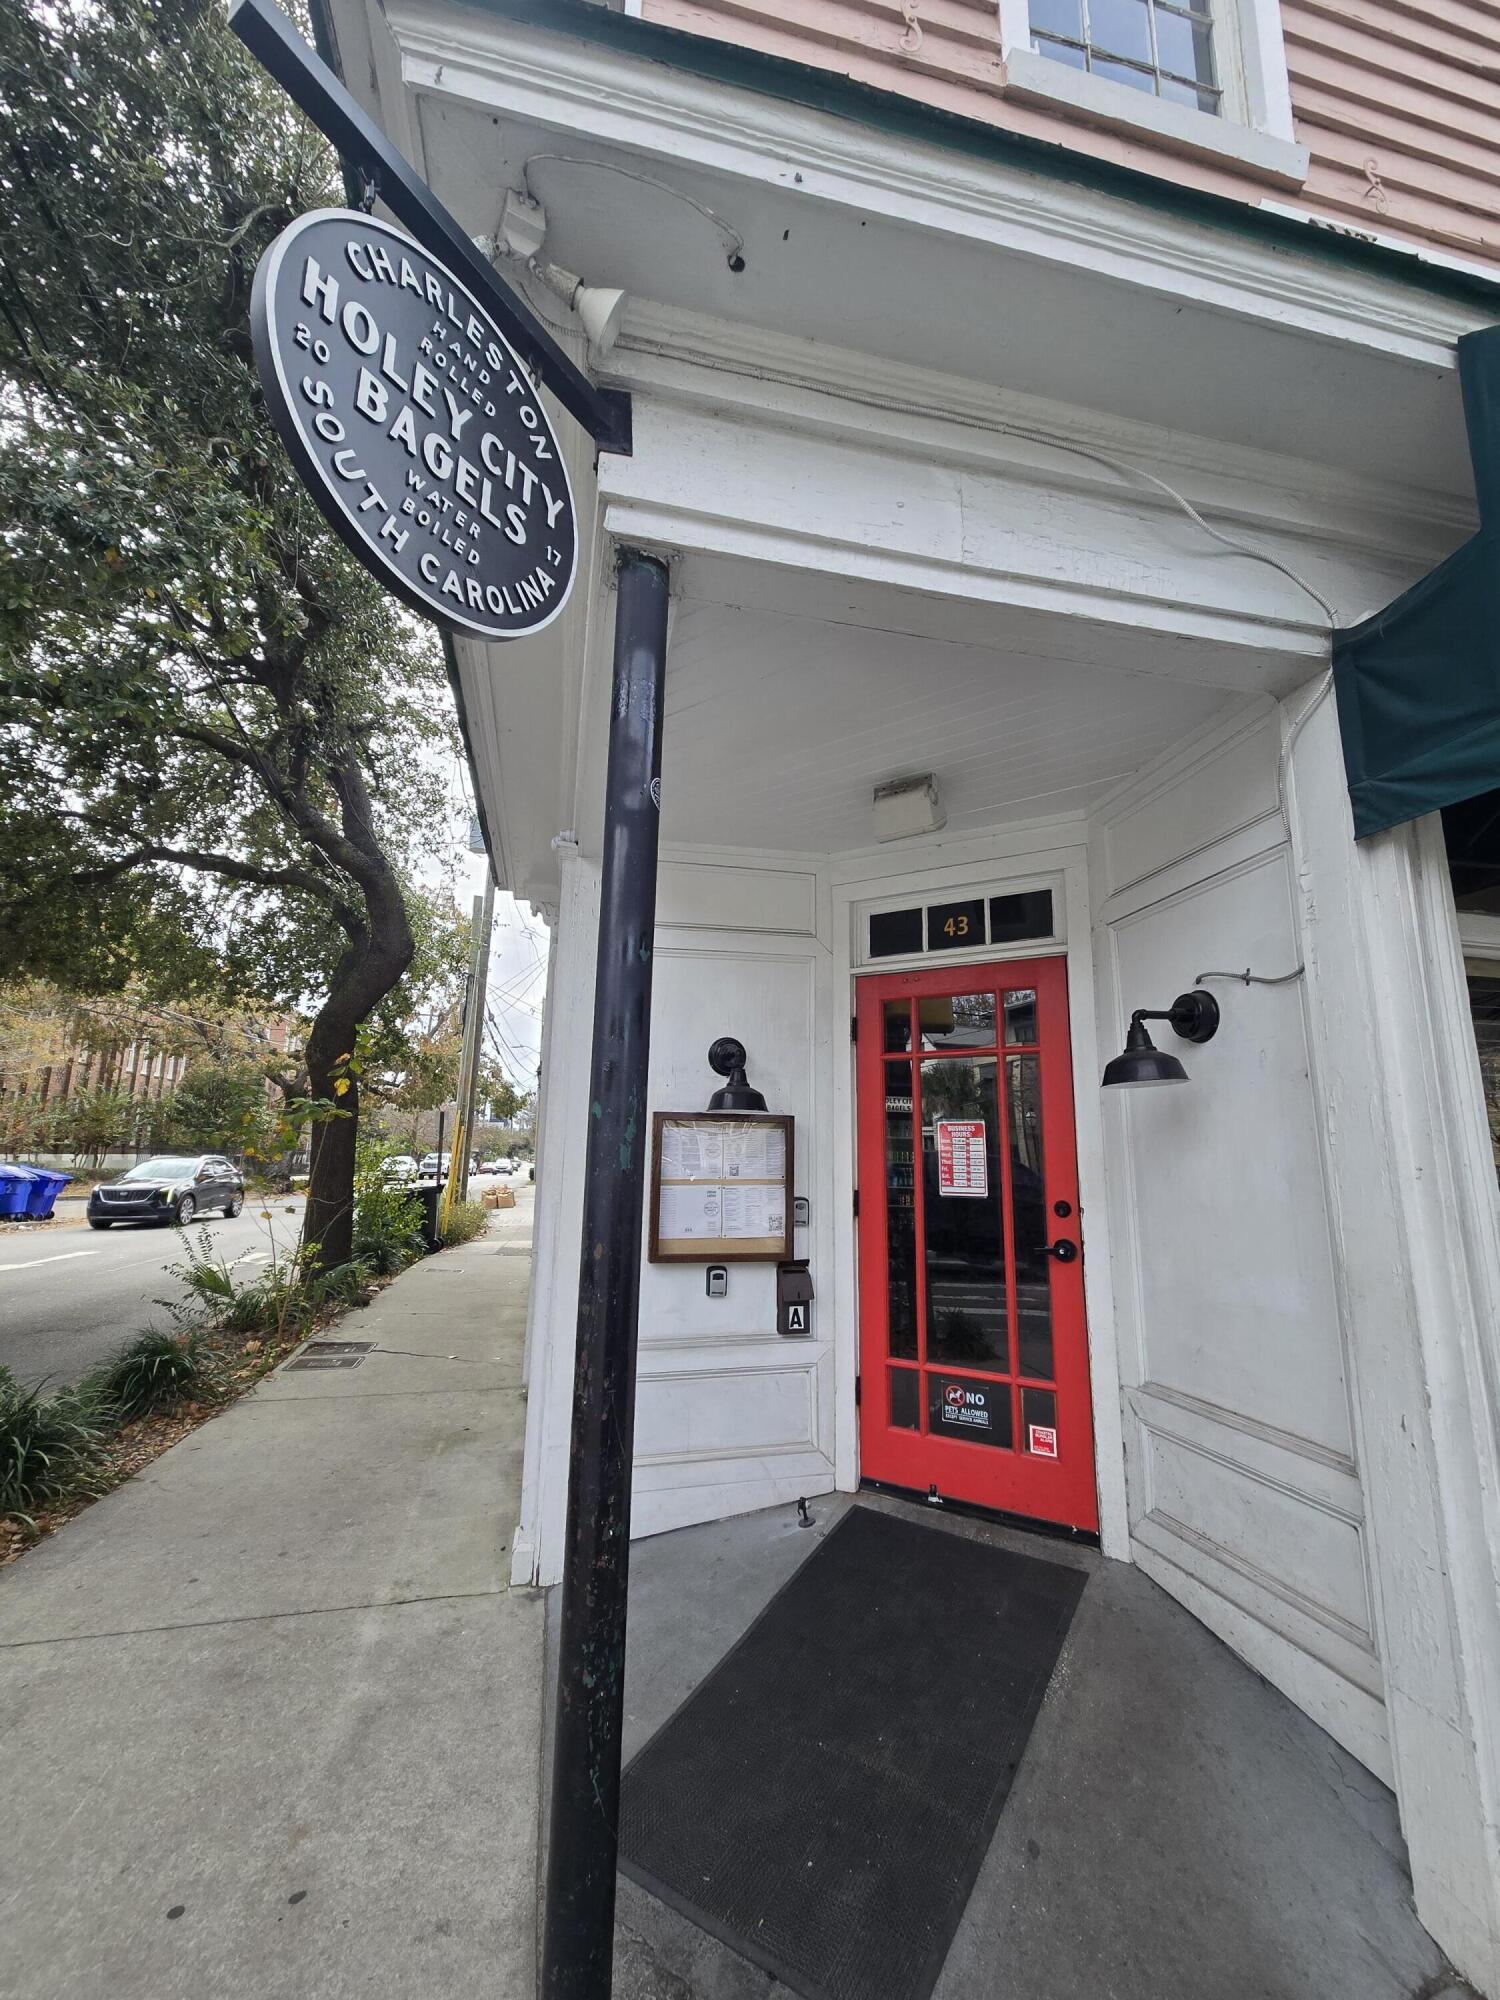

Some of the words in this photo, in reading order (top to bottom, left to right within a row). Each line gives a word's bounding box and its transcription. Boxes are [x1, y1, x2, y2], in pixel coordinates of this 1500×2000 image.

[295, 322, 331, 364] 20
[346, 240, 553, 460] CHARLESTON
[432, 320, 491, 386] HAND
[303, 256, 474, 441] HOLEY
[480, 431, 565, 530] CITY
[419, 336, 497, 418] ROLLED
[356, 366, 527, 545] BAGELS
[303, 375, 409, 553] SOUTH
[419, 552, 556, 615] CAROLINA
[406, 468, 481, 540] WATER
[400, 497, 481, 566] BOILED
[545, 545, 562, 566] 17
[943, 916, 969, 936] 43
[886, 1104, 911, 1112] BAGELS
[789, 1307, 803, 1328] A
[945, 1405, 959, 1414] PETS
[961, 1407, 989, 1418] ALLOWED
[966, 1392, 985, 1405] NO
